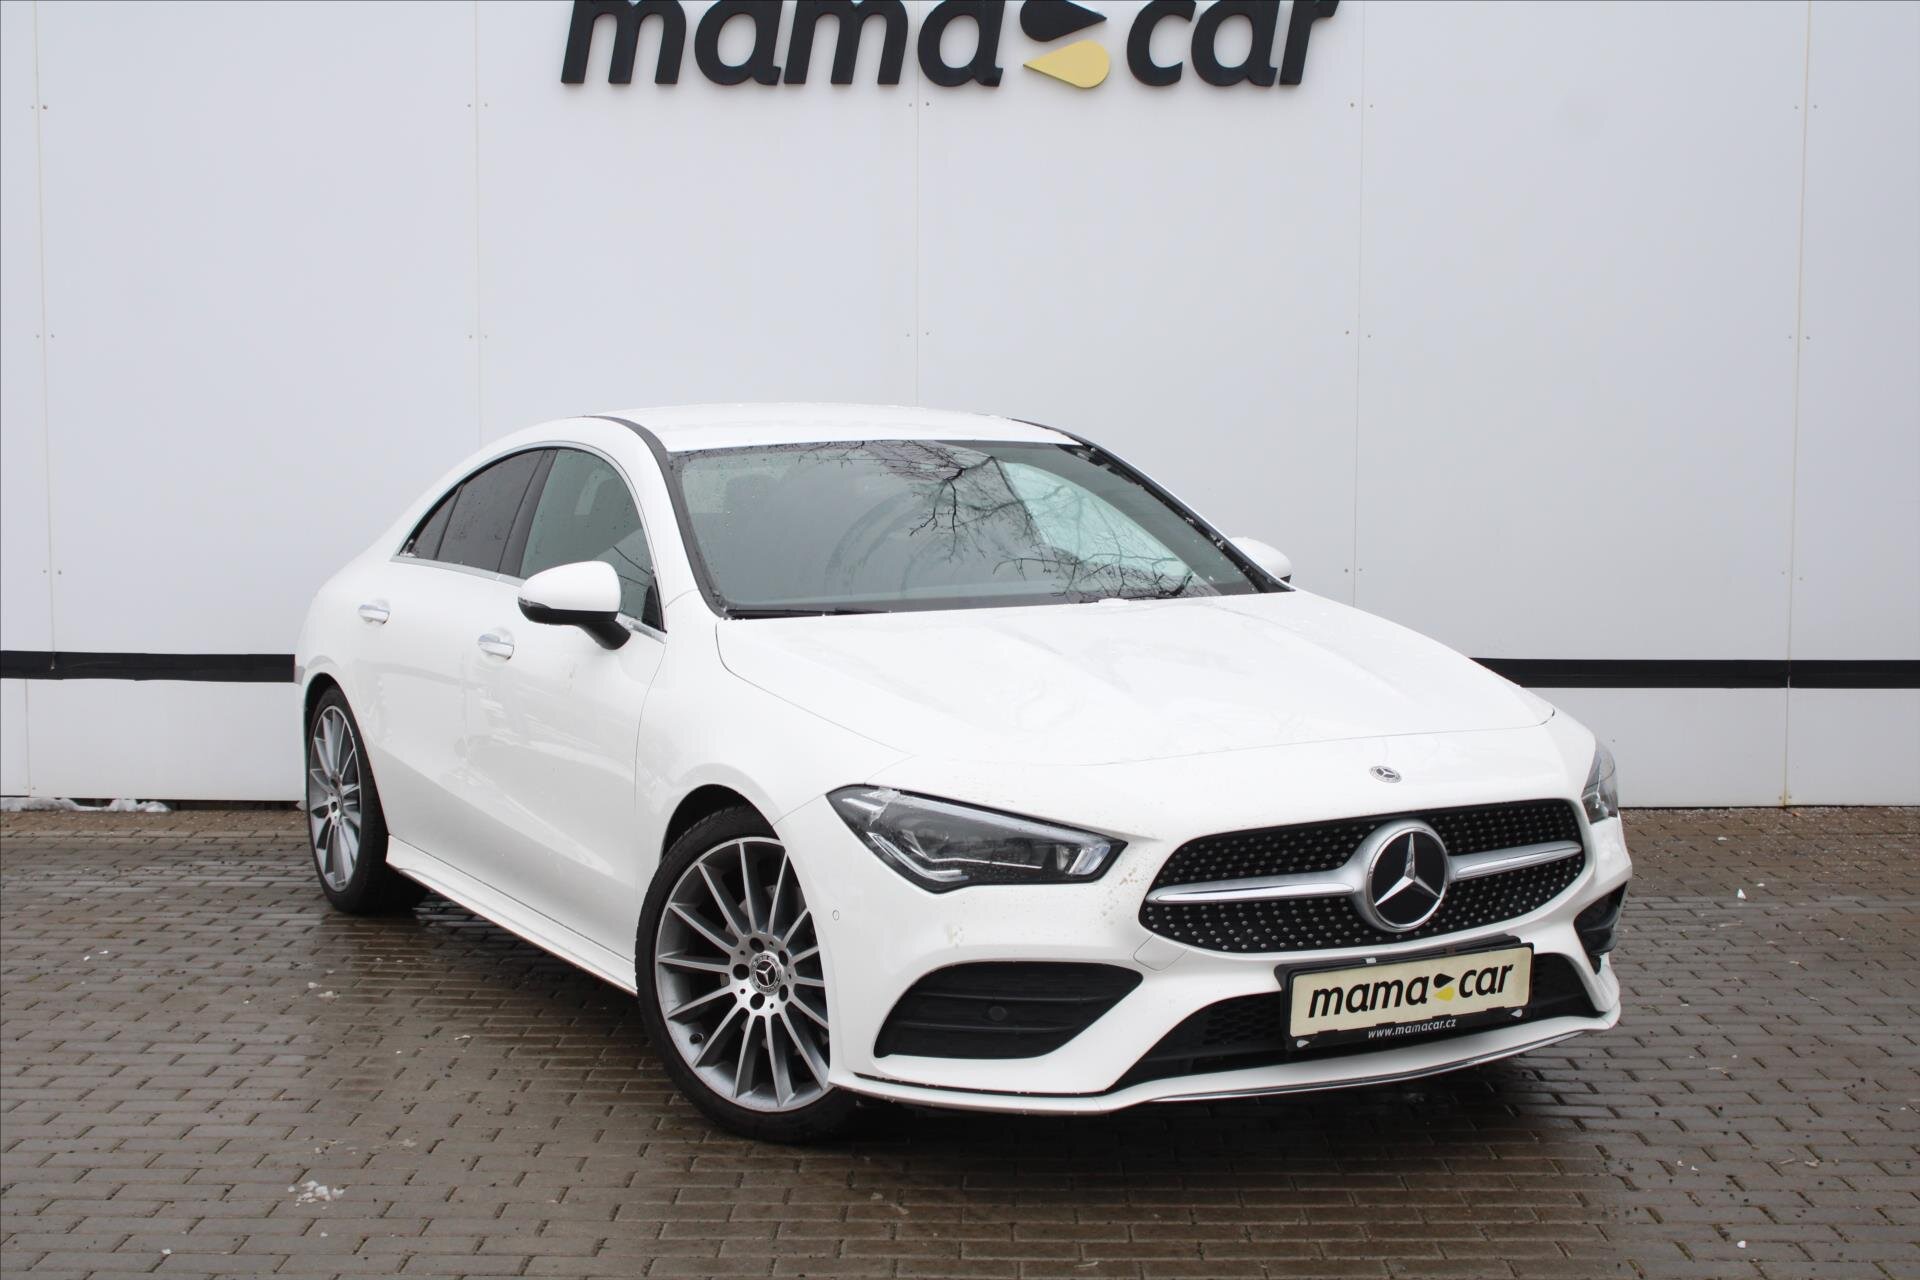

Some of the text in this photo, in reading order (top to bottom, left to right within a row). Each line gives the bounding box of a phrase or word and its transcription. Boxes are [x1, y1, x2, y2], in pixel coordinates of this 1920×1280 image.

[561, 0, 1341, 87] mama car
[1308, 964, 1513, 1018] mama car
[1368, 1018, 1456, 1039] www.mamacar.cz
